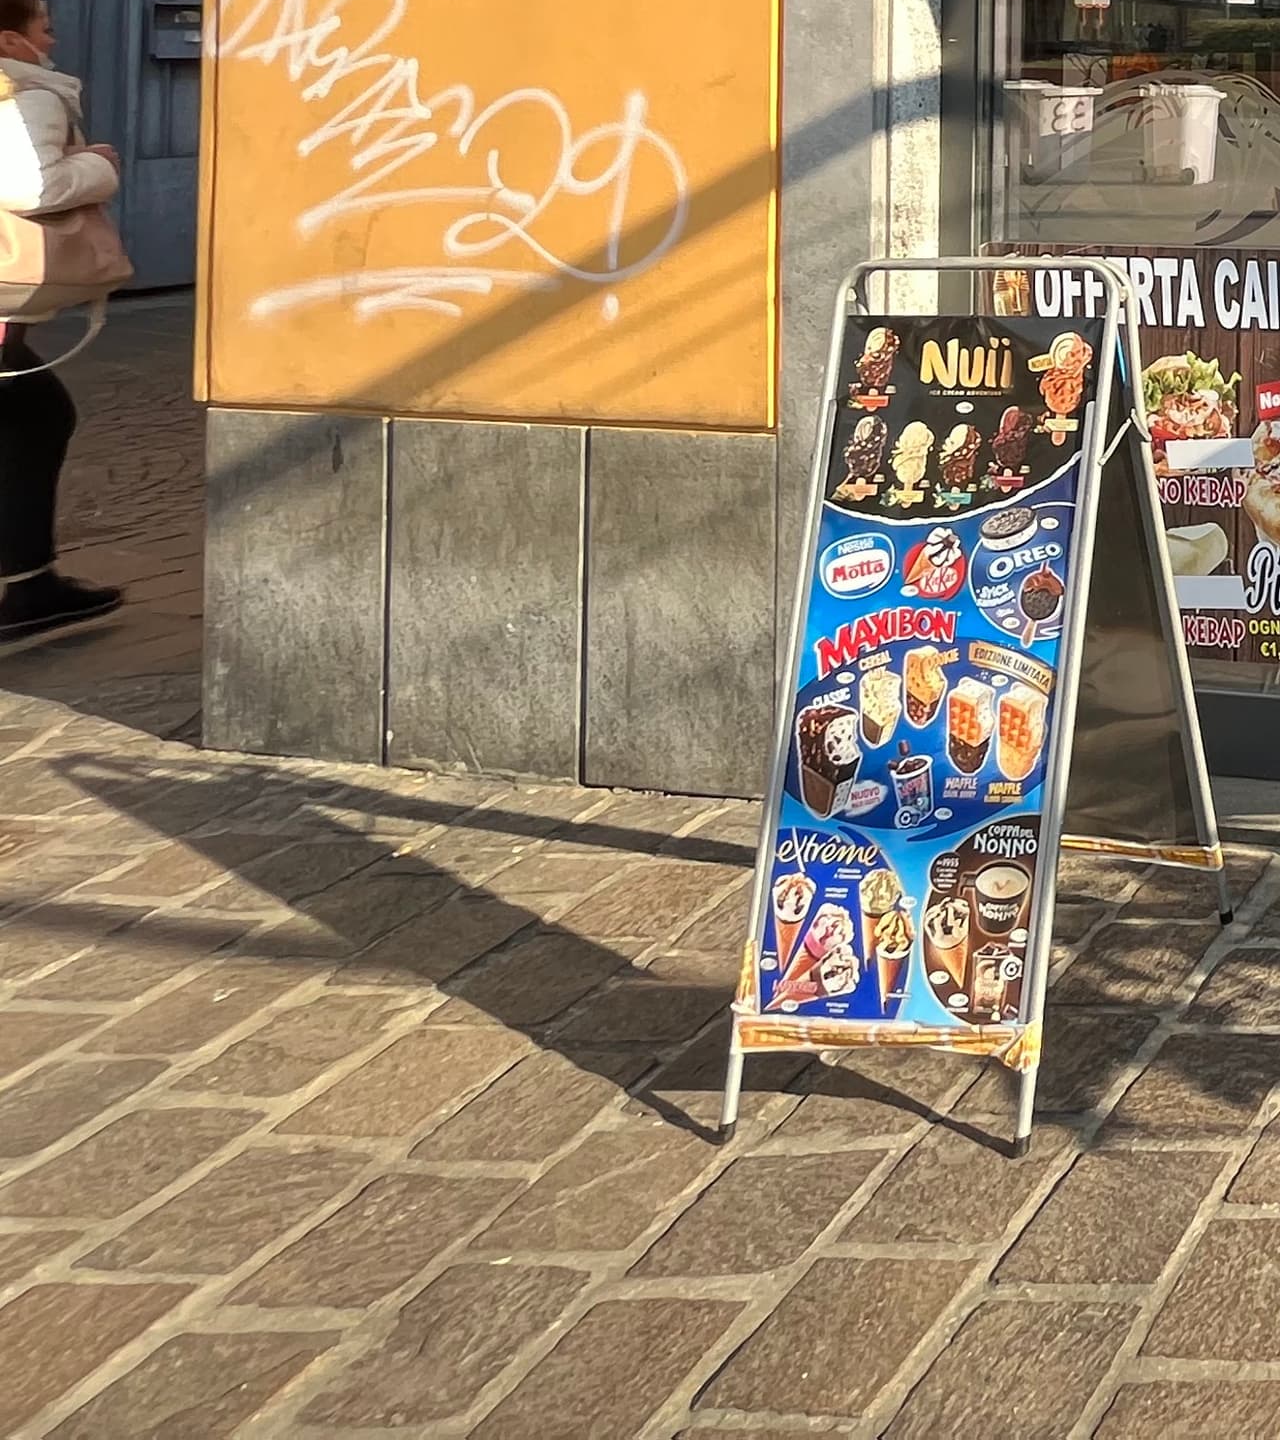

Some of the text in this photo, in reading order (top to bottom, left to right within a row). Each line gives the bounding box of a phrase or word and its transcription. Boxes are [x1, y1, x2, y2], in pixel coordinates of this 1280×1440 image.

[919, 336, 1013, 389] Nuii
[1183, 475, 1248, 508] KEBAP
[831, 559, 886, 584] Motta
[988, 544, 1063, 582] OREO
[815, 606, 957, 680] MAXIBON
[1182, 615, 1247, 649] KEBAP
[973, 646, 1050, 690] EDIZIONE LIMITATA
[973, 833, 1037, 858] NONNO
[987, 824, 1020, 837] COPPA
[776, 826, 881, 872] extrême
